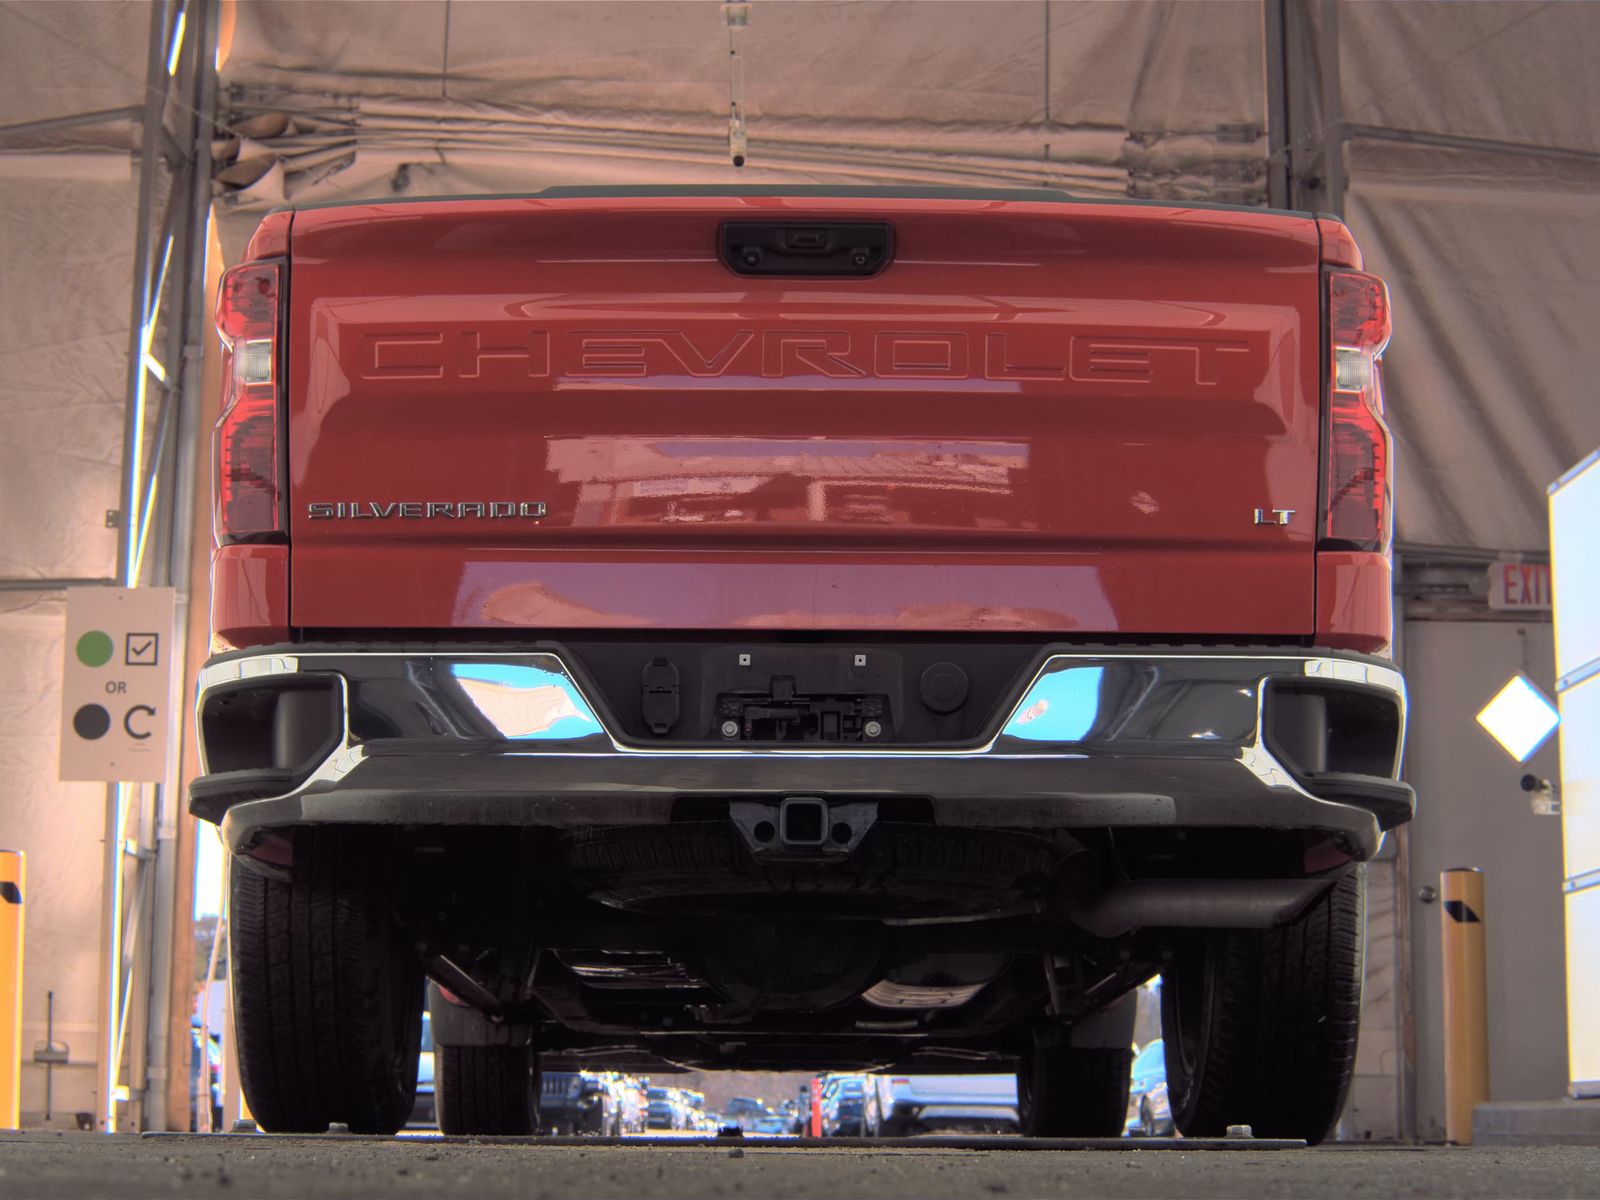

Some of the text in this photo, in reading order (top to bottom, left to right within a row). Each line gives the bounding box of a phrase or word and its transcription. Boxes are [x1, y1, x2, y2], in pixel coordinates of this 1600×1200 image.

[361, 330, 1250, 387] CHEVROLET
[308, 502, 547, 519] SILVERADO
[1254, 508, 1296, 525] LT
[105, 681, 127, 694] OR
